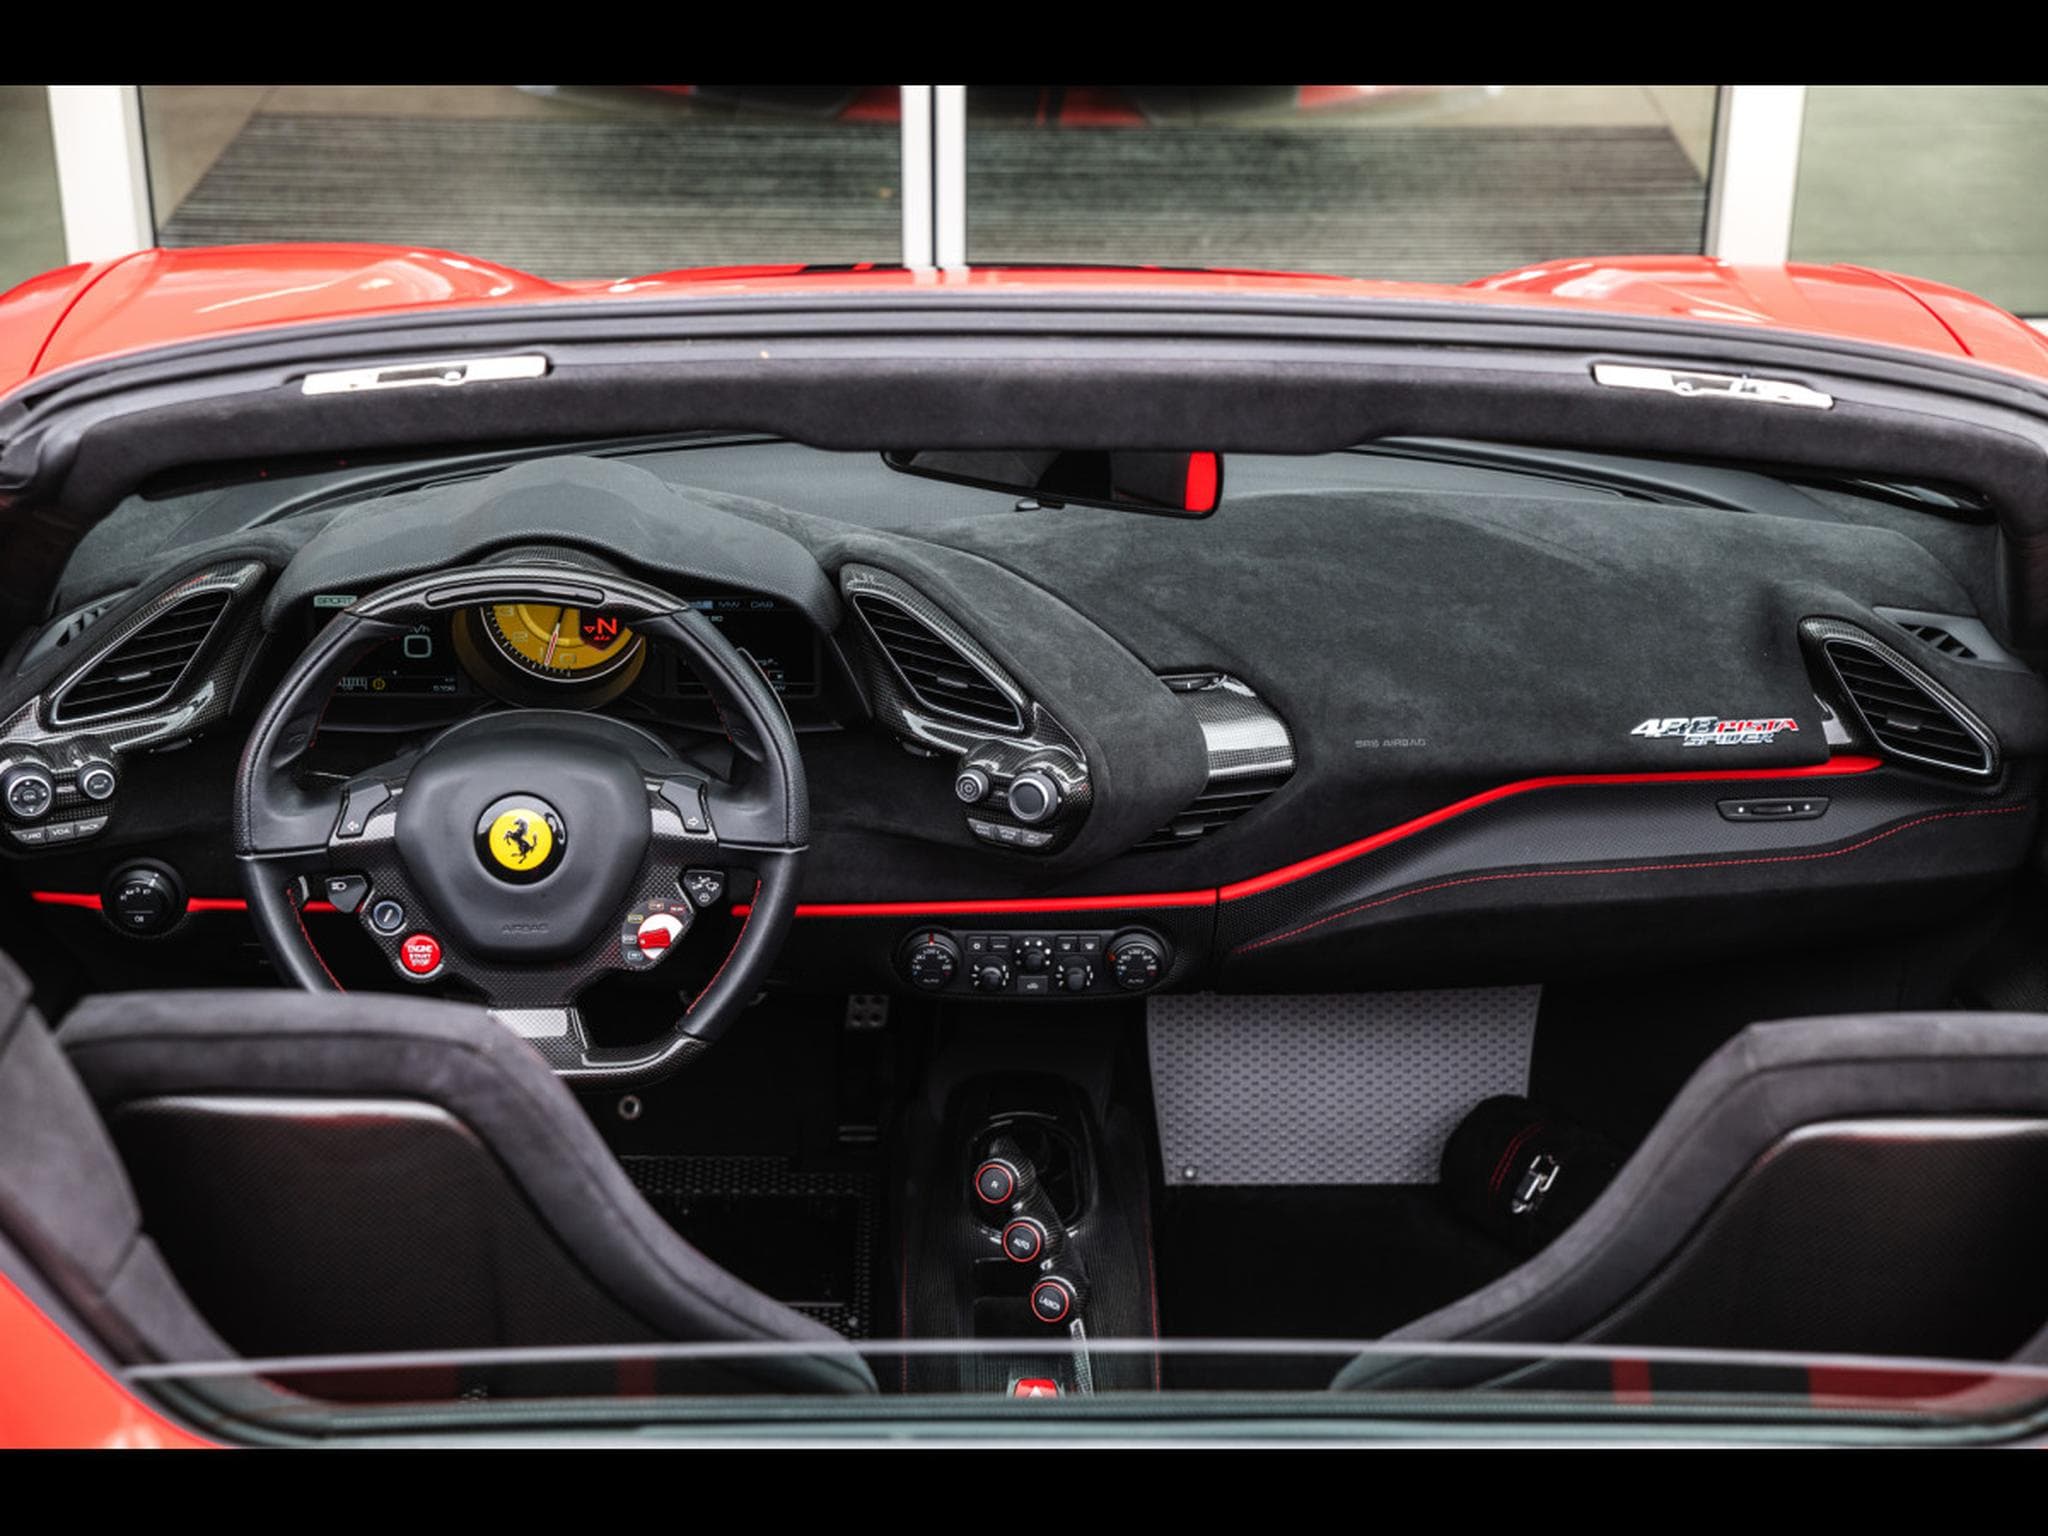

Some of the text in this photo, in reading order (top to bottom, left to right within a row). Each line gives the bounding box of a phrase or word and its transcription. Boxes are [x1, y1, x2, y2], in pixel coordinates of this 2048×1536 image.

[597, 617, 617, 635] N
[1717, 718, 1799, 733] PISTA
[1683, 733, 1774, 746] SPIDER
[1013, 1237, 1030, 1250] AUTO
